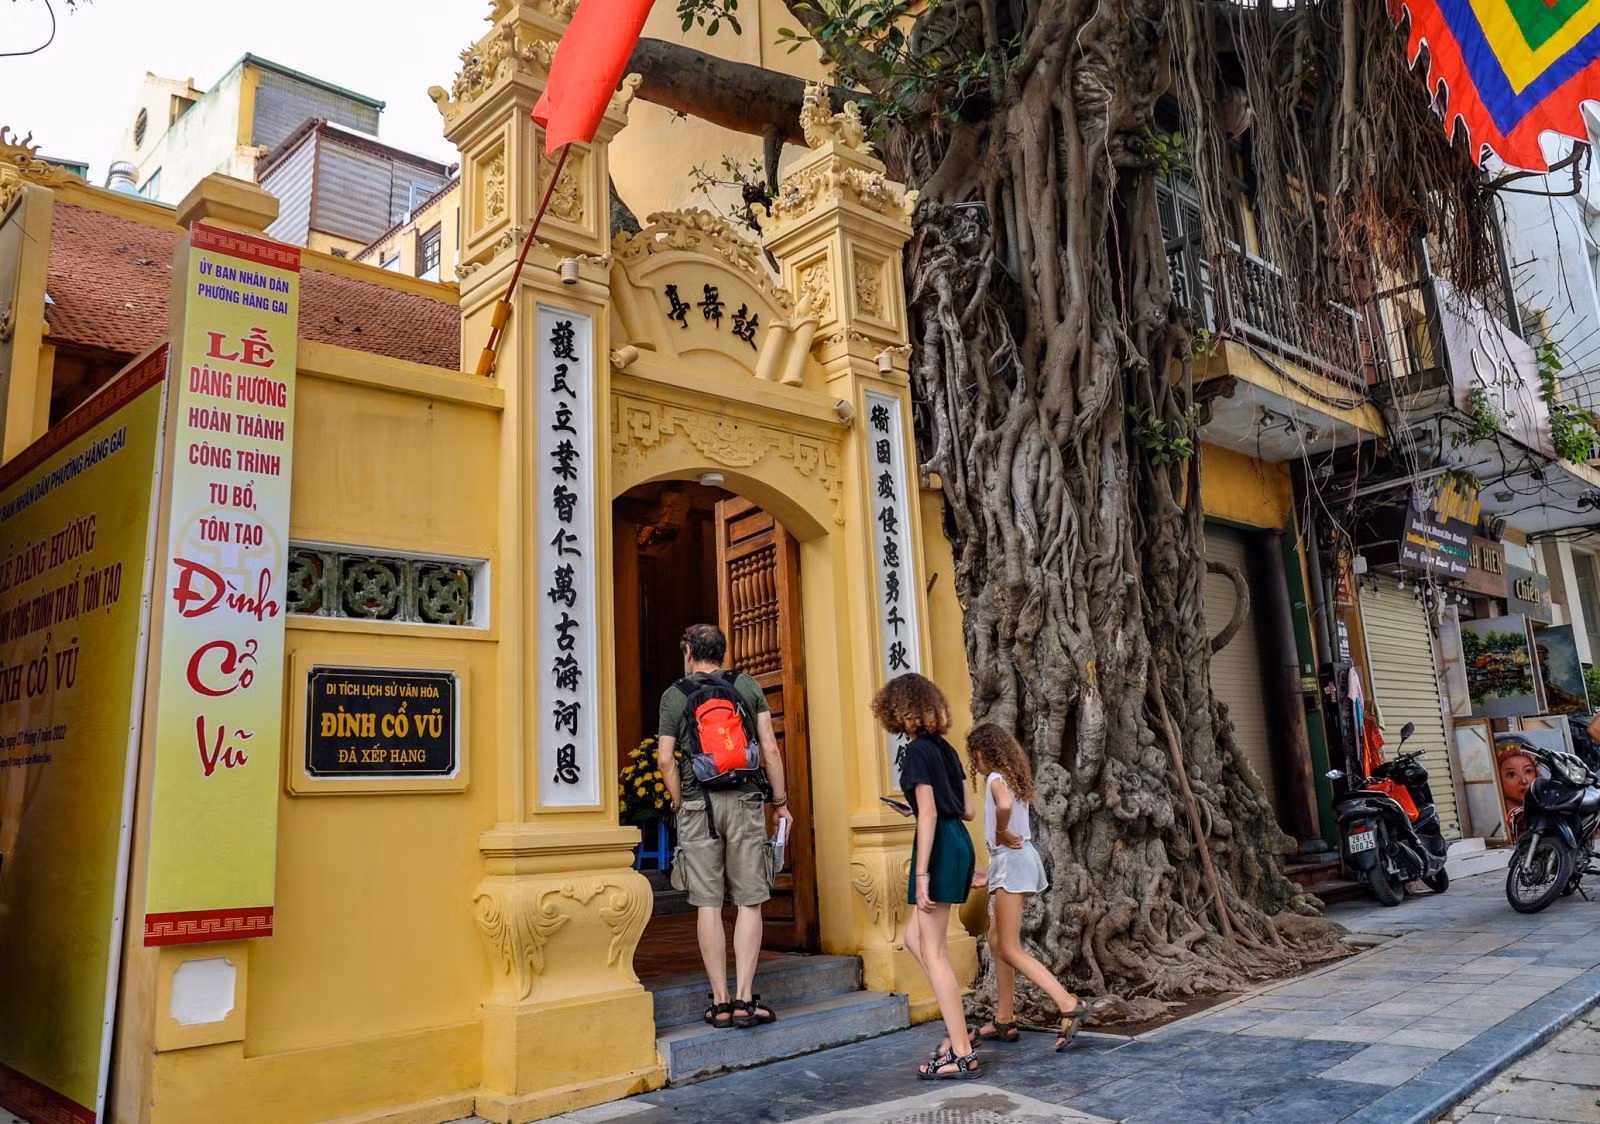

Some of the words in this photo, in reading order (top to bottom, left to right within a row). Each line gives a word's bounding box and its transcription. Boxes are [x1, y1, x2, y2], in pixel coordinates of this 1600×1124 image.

[199, 257, 213, 276] ỦY
[215, 265, 237, 282] BAN
[239, 271, 267, 289] NHÂN
[269, 277, 289, 294] DÂN
[197, 283, 240, 304] PHƯỜNG
[242, 292, 269, 310] HÀNG
[271, 299, 288, 315] GAI
[206, 327, 275, 368] LỄ
[189, 363, 232, 399] DÂNG
[236, 375, 287, 409] HƯƠNG
[110, 425, 127, 453] GAI
[188, 406, 232, 433] HOÀN
[236, 413, 284, 442] THÀNH
[189, 441, 232, 470] CÔNG
[236, 448, 280, 476] TRÌNH
[209, 482, 229, 506] TU
[232, 480, 257, 511] BỔ,
[48, 512, 97, 570] HƯƠNG
[200, 515, 230, 543] TÔN
[234, 522, 263, 550] TẠO
[82, 565, 102, 614] TÔN
[102, 560, 122, 615] TẠO
[172, 557, 280, 622] Đình
[26, 631, 51, 698] CỔ
[56, 636, 80, 690] VŨ
[186, 638, 258, 697] Cổ
[326, 683, 337, 695] DI
[339, 681, 360, 696] TÍCH
[362, 684, 383, 700] LỊCH
[384, 682, 398, 697] SỬ
[399, 683, 418, 698] VĂN
[420, 683, 440, 698] HÓA
[321, 706, 376, 737] ĐÌNH
[381, 701, 409, 738] CỔ
[414, 708, 443, 738] VŨ
[196, 715, 254, 777] Vũ
[338, 746, 358, 763] ĐÃ
[361, 743, 387, 763] XẾP
[390, 749, 426, 766] HẠNG
